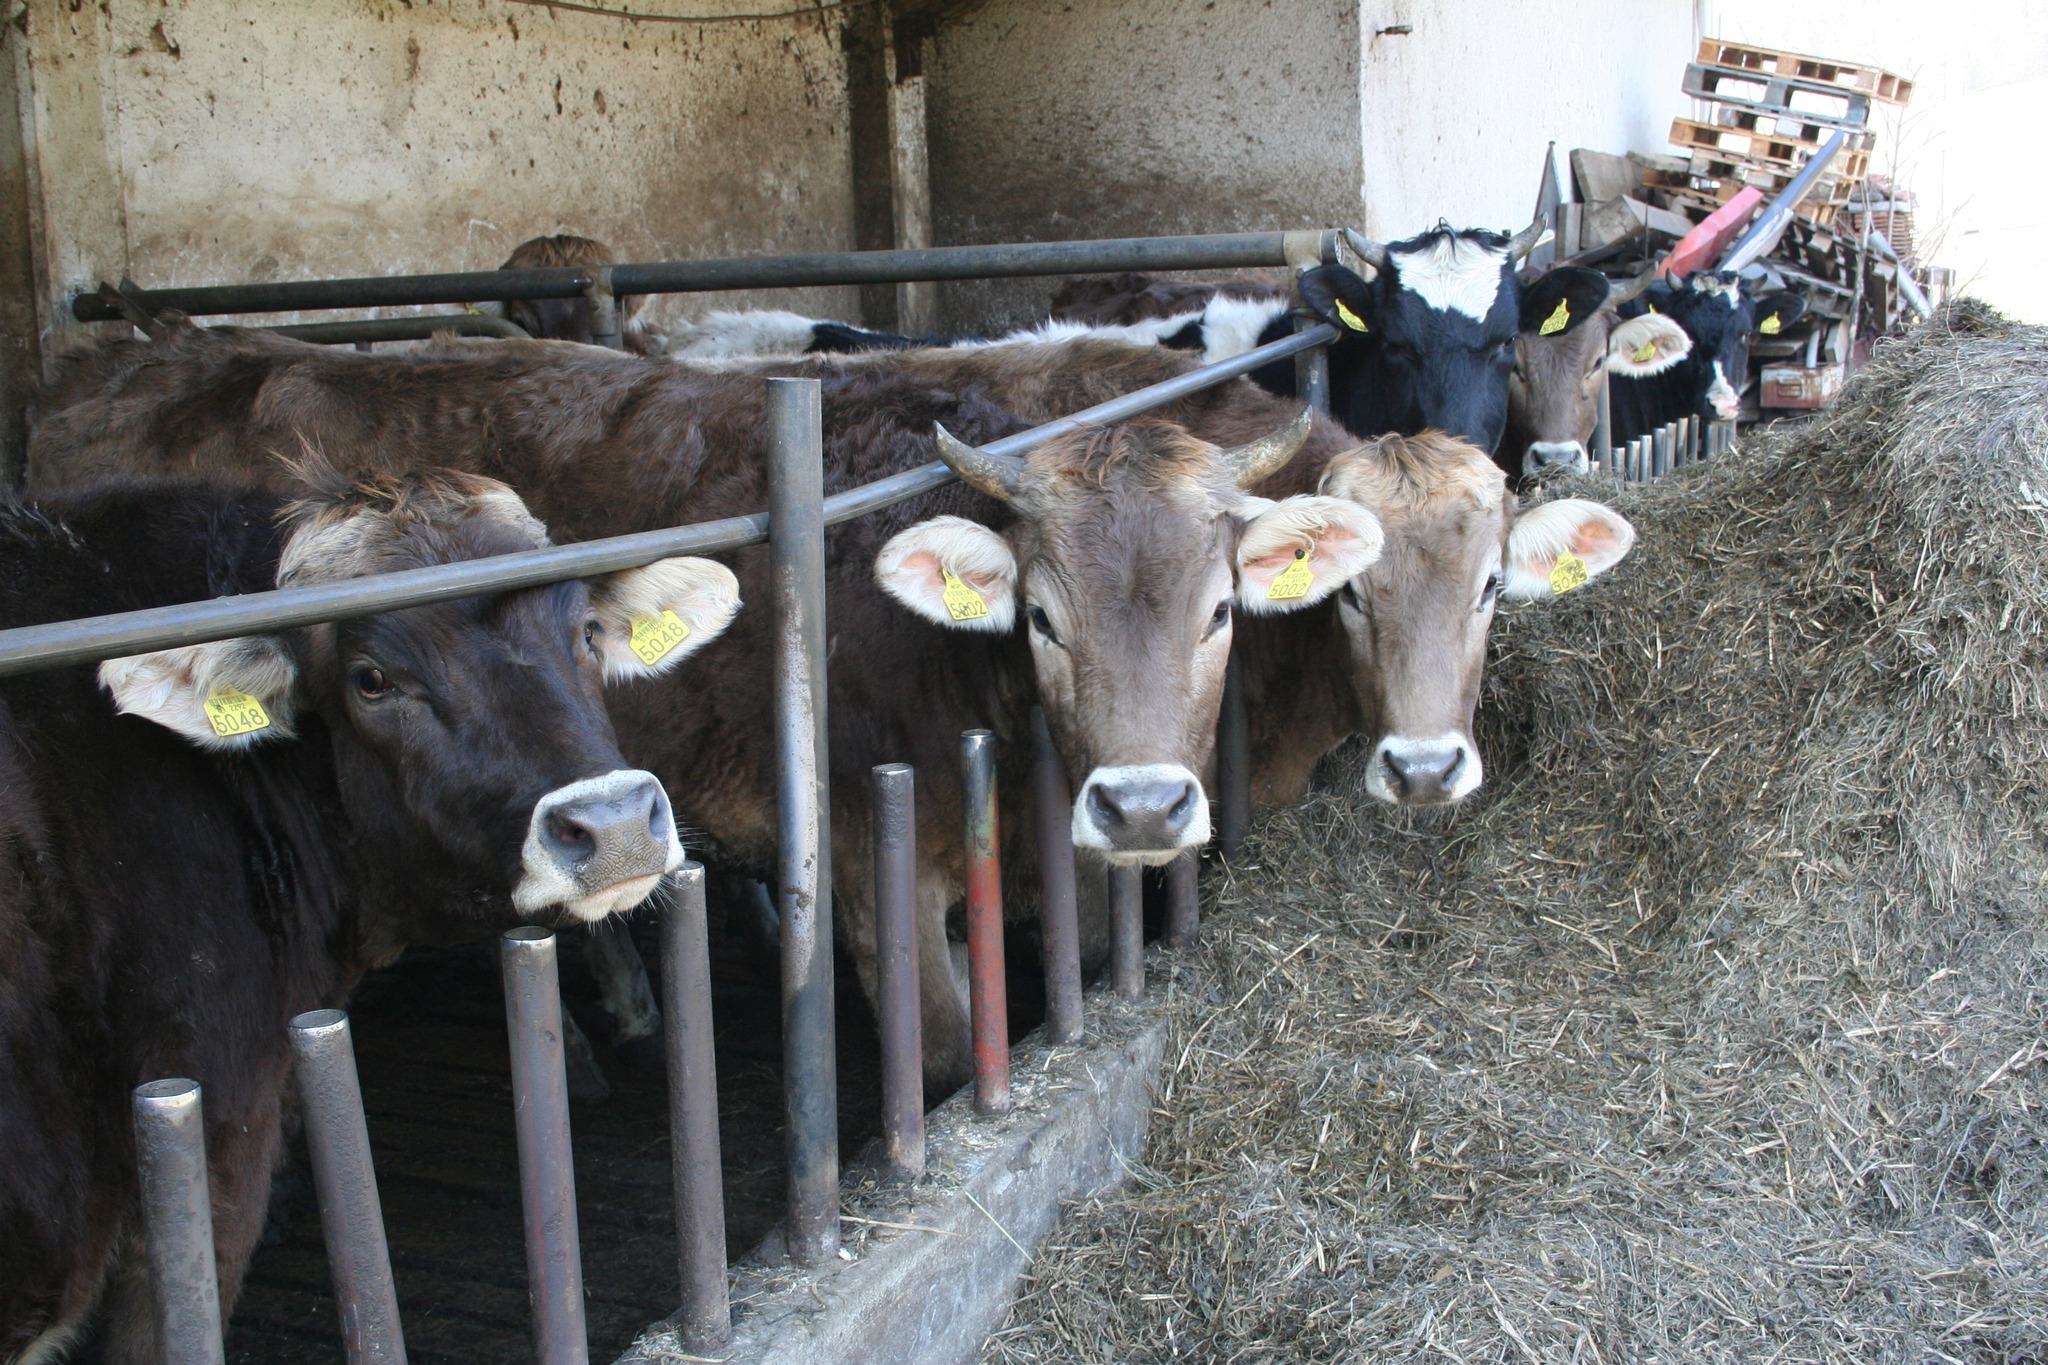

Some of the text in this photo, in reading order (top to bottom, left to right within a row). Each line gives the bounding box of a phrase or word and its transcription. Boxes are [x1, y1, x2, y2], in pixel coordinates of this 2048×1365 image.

[1269, 582, 1307, 597] 5002
[950, 600, 988, 618] 5002
[638, 622, 684, 662] 5048
[229, 702, 247, 712] 2292
[212, 708, 265, 735] 5048
